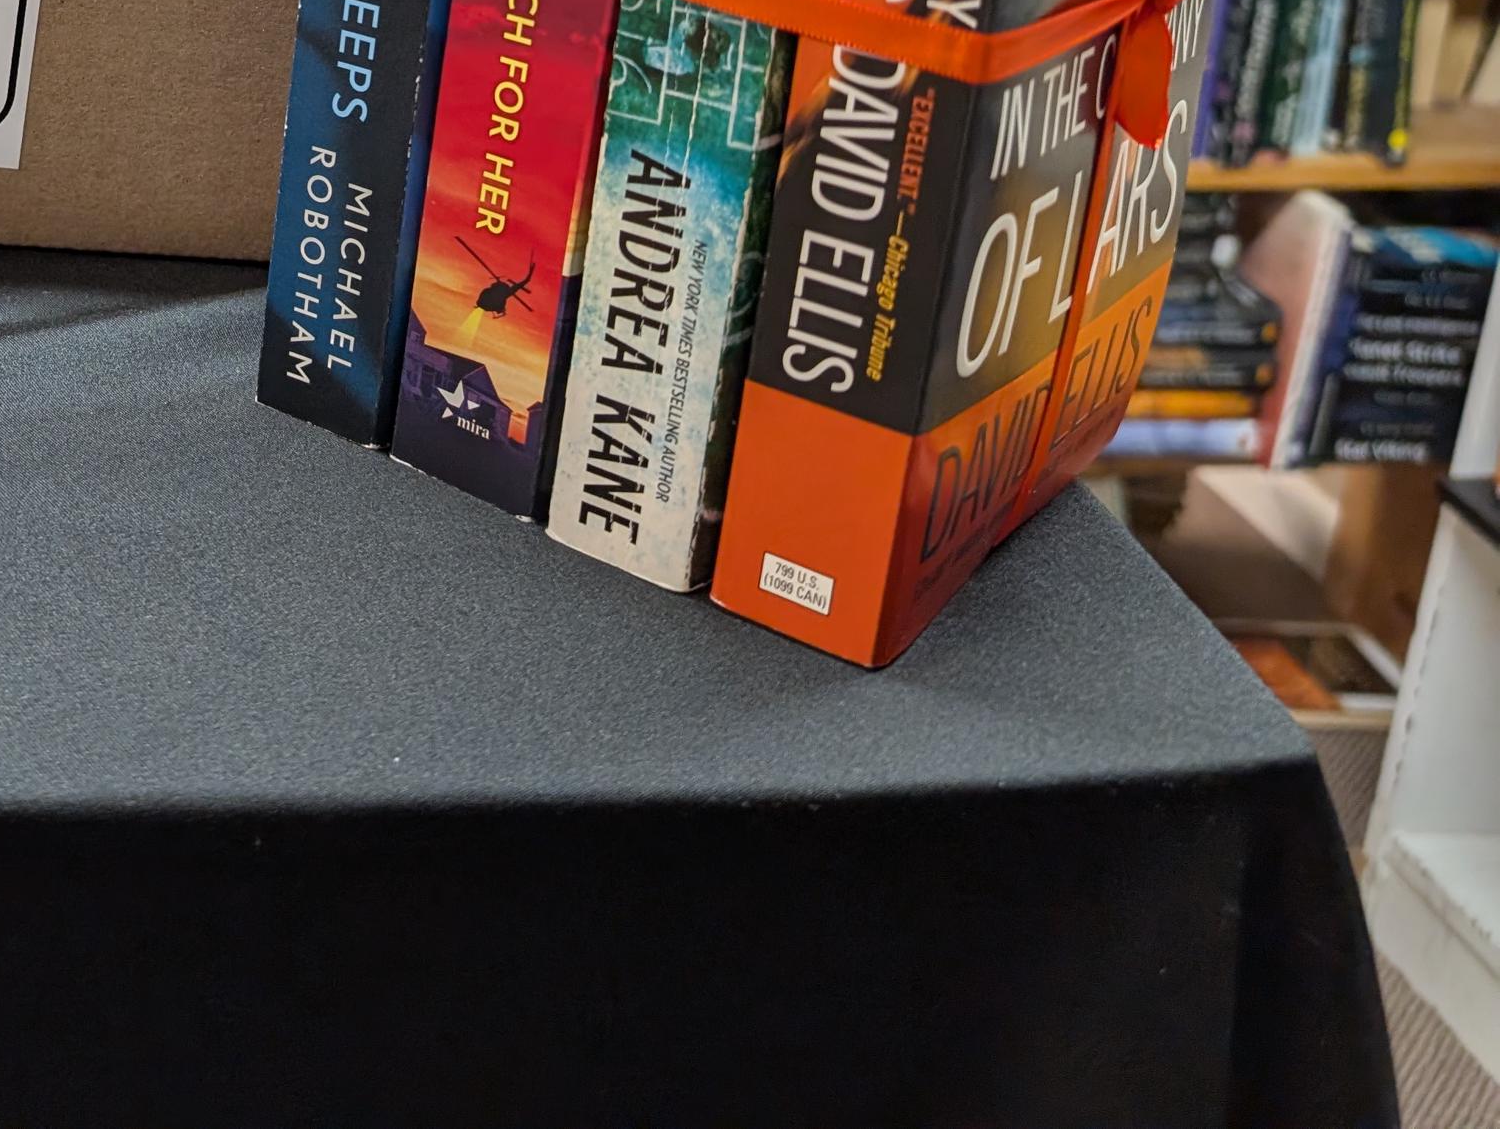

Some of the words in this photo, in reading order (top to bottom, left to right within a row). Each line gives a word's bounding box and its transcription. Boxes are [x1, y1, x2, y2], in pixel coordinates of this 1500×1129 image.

[488, 54, 530, 142] FOR
[809, 43, 907, 223] DAVID
[989, 78, 1036, 182] IN
[1039, 45, 1097, 157] THE
[474, 151, 515, 237] HER
[285, 144, 337, 385] ROBOTHAM
[326, 183, 373, 371] MICHAEL
[600, 148, 694, 377] ANDREA
[690, 239, 709, 277] NEW
[956, 185, 1061, 379] OF
[1048, 98, 1188, 324] LARS
[683, 274, 706, 312] YORK
[780, 227, 876, 395] ELLIS
[677, 317, 698, 359] TIMES
[865, 312, 897, 383] Tribune
[1049, 295, 1153, 451] ELLIS
[456, 415, 491, 441] mira
[662, 359, 692, 446] BESTSELLING
[577, 393, 656, 545] KANE
[654, 445, 679, 504] AUTHOR
[762, 571, 795, 596] (1099
[795, 584, 828, 611] CAN)
[774, 561, 796, 580] 799
[797, 569, 820, 592] U.S.
